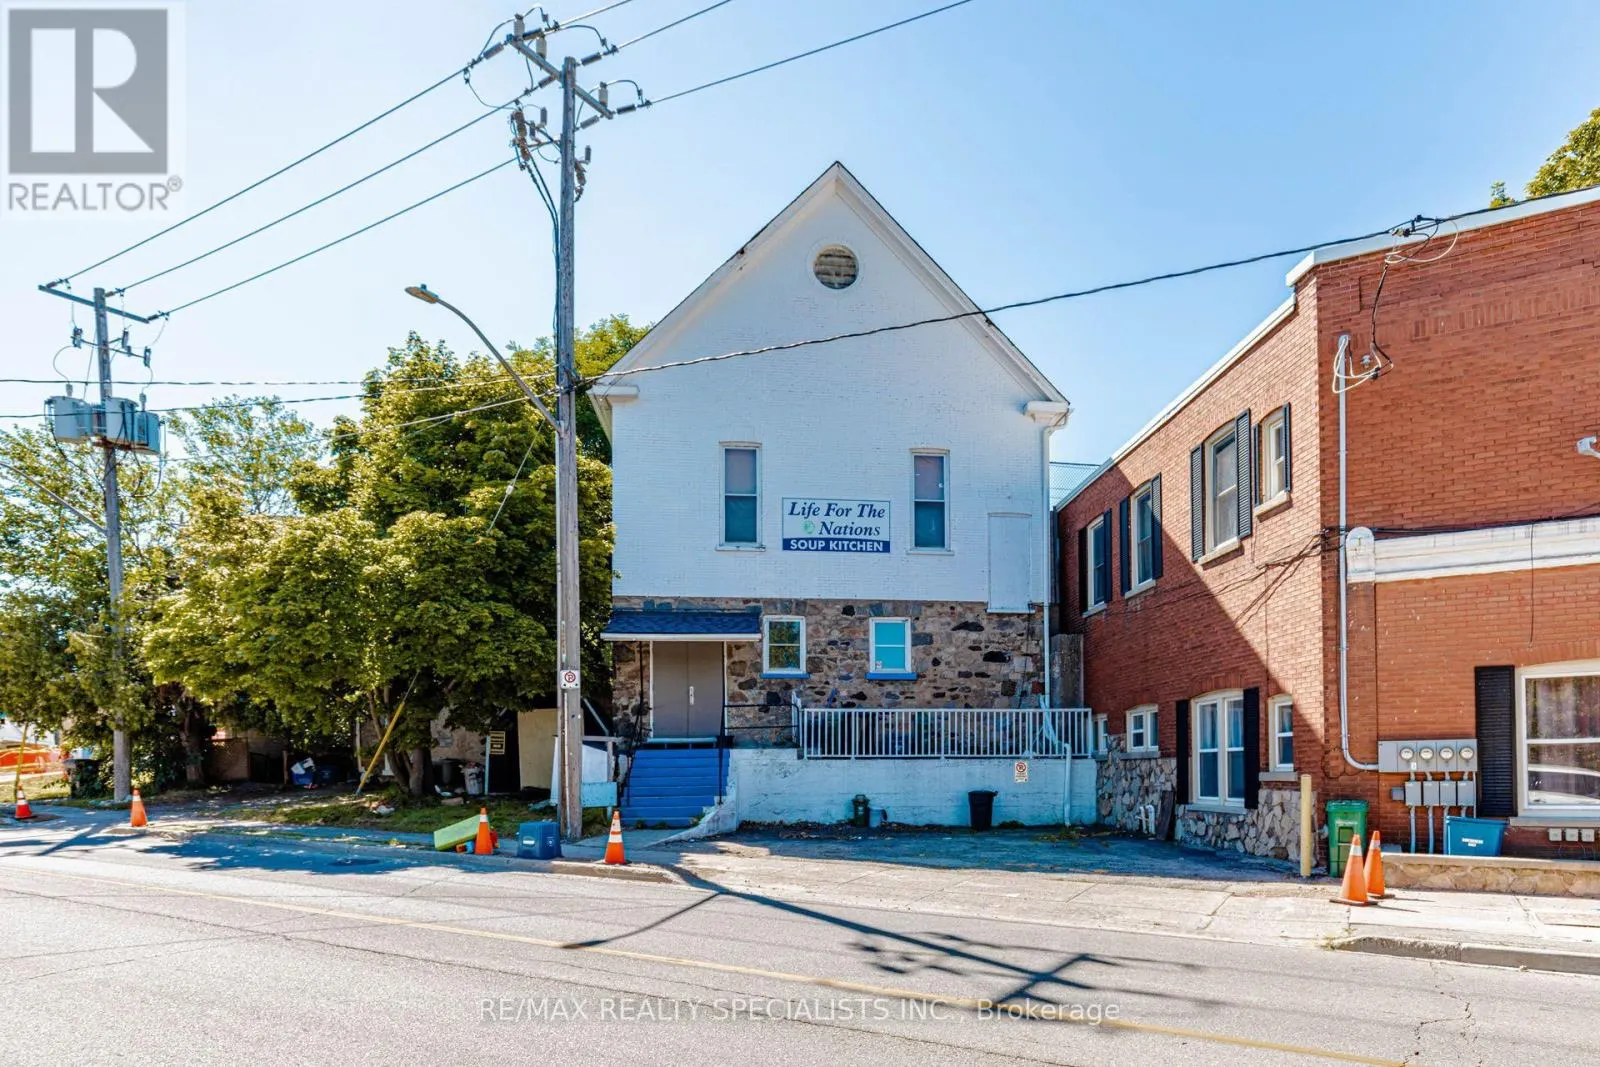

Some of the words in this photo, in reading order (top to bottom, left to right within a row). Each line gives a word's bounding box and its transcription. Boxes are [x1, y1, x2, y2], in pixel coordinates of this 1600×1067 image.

[788, 501, 820, 519] Life
[824, 502, 852, 517] For
[857, 503, 885, 518] The
[818, 521, 881, 536] Nations
[790, 539, 826, 551] SOUP
[829, 540, 883, 552] KITCHEN
